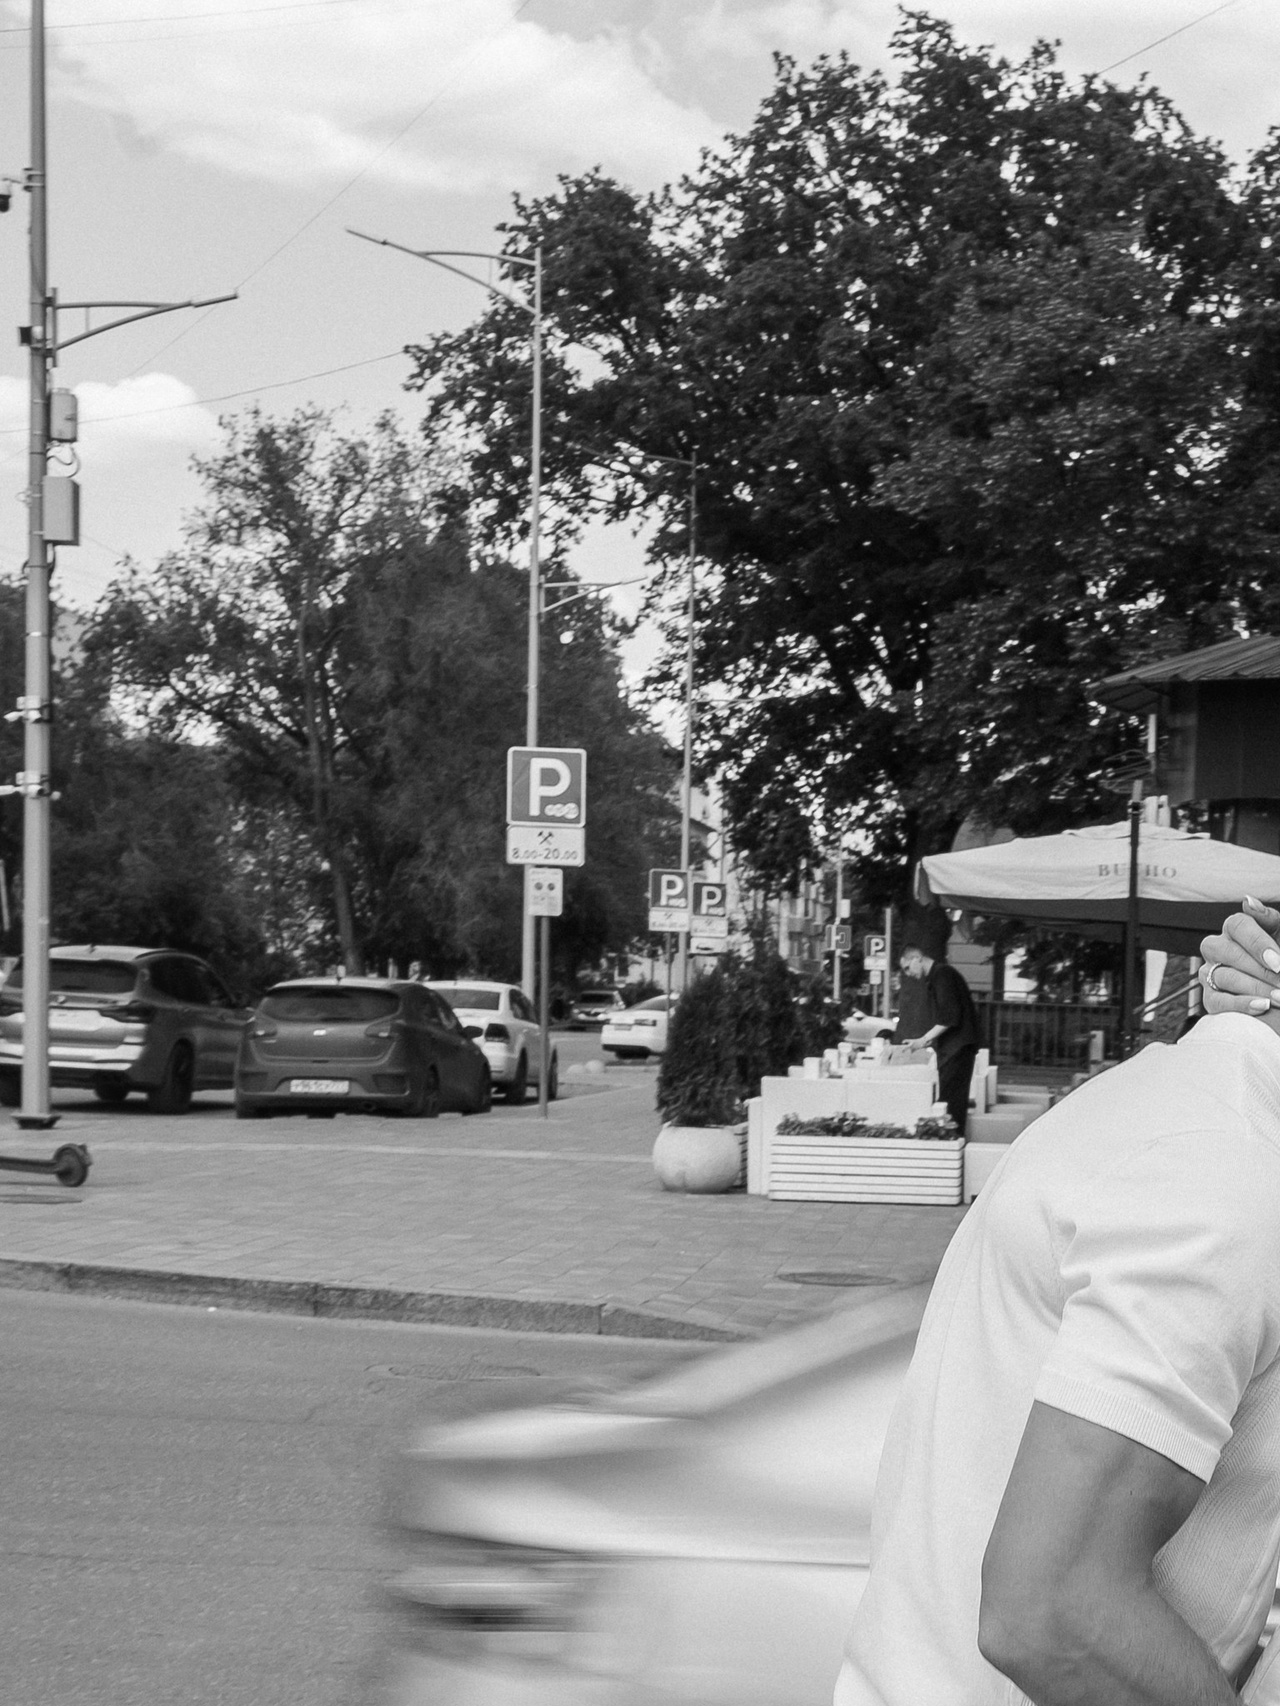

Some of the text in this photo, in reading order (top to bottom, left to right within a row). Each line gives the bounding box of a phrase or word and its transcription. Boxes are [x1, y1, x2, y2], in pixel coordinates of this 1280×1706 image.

[529, 757, 571, 816] P
[1098, 863, 1177, 878] BUHO
[660, 874, 684, 906] P
[700, 885, 722, 915] P
[870, 938, 884, 956] P
